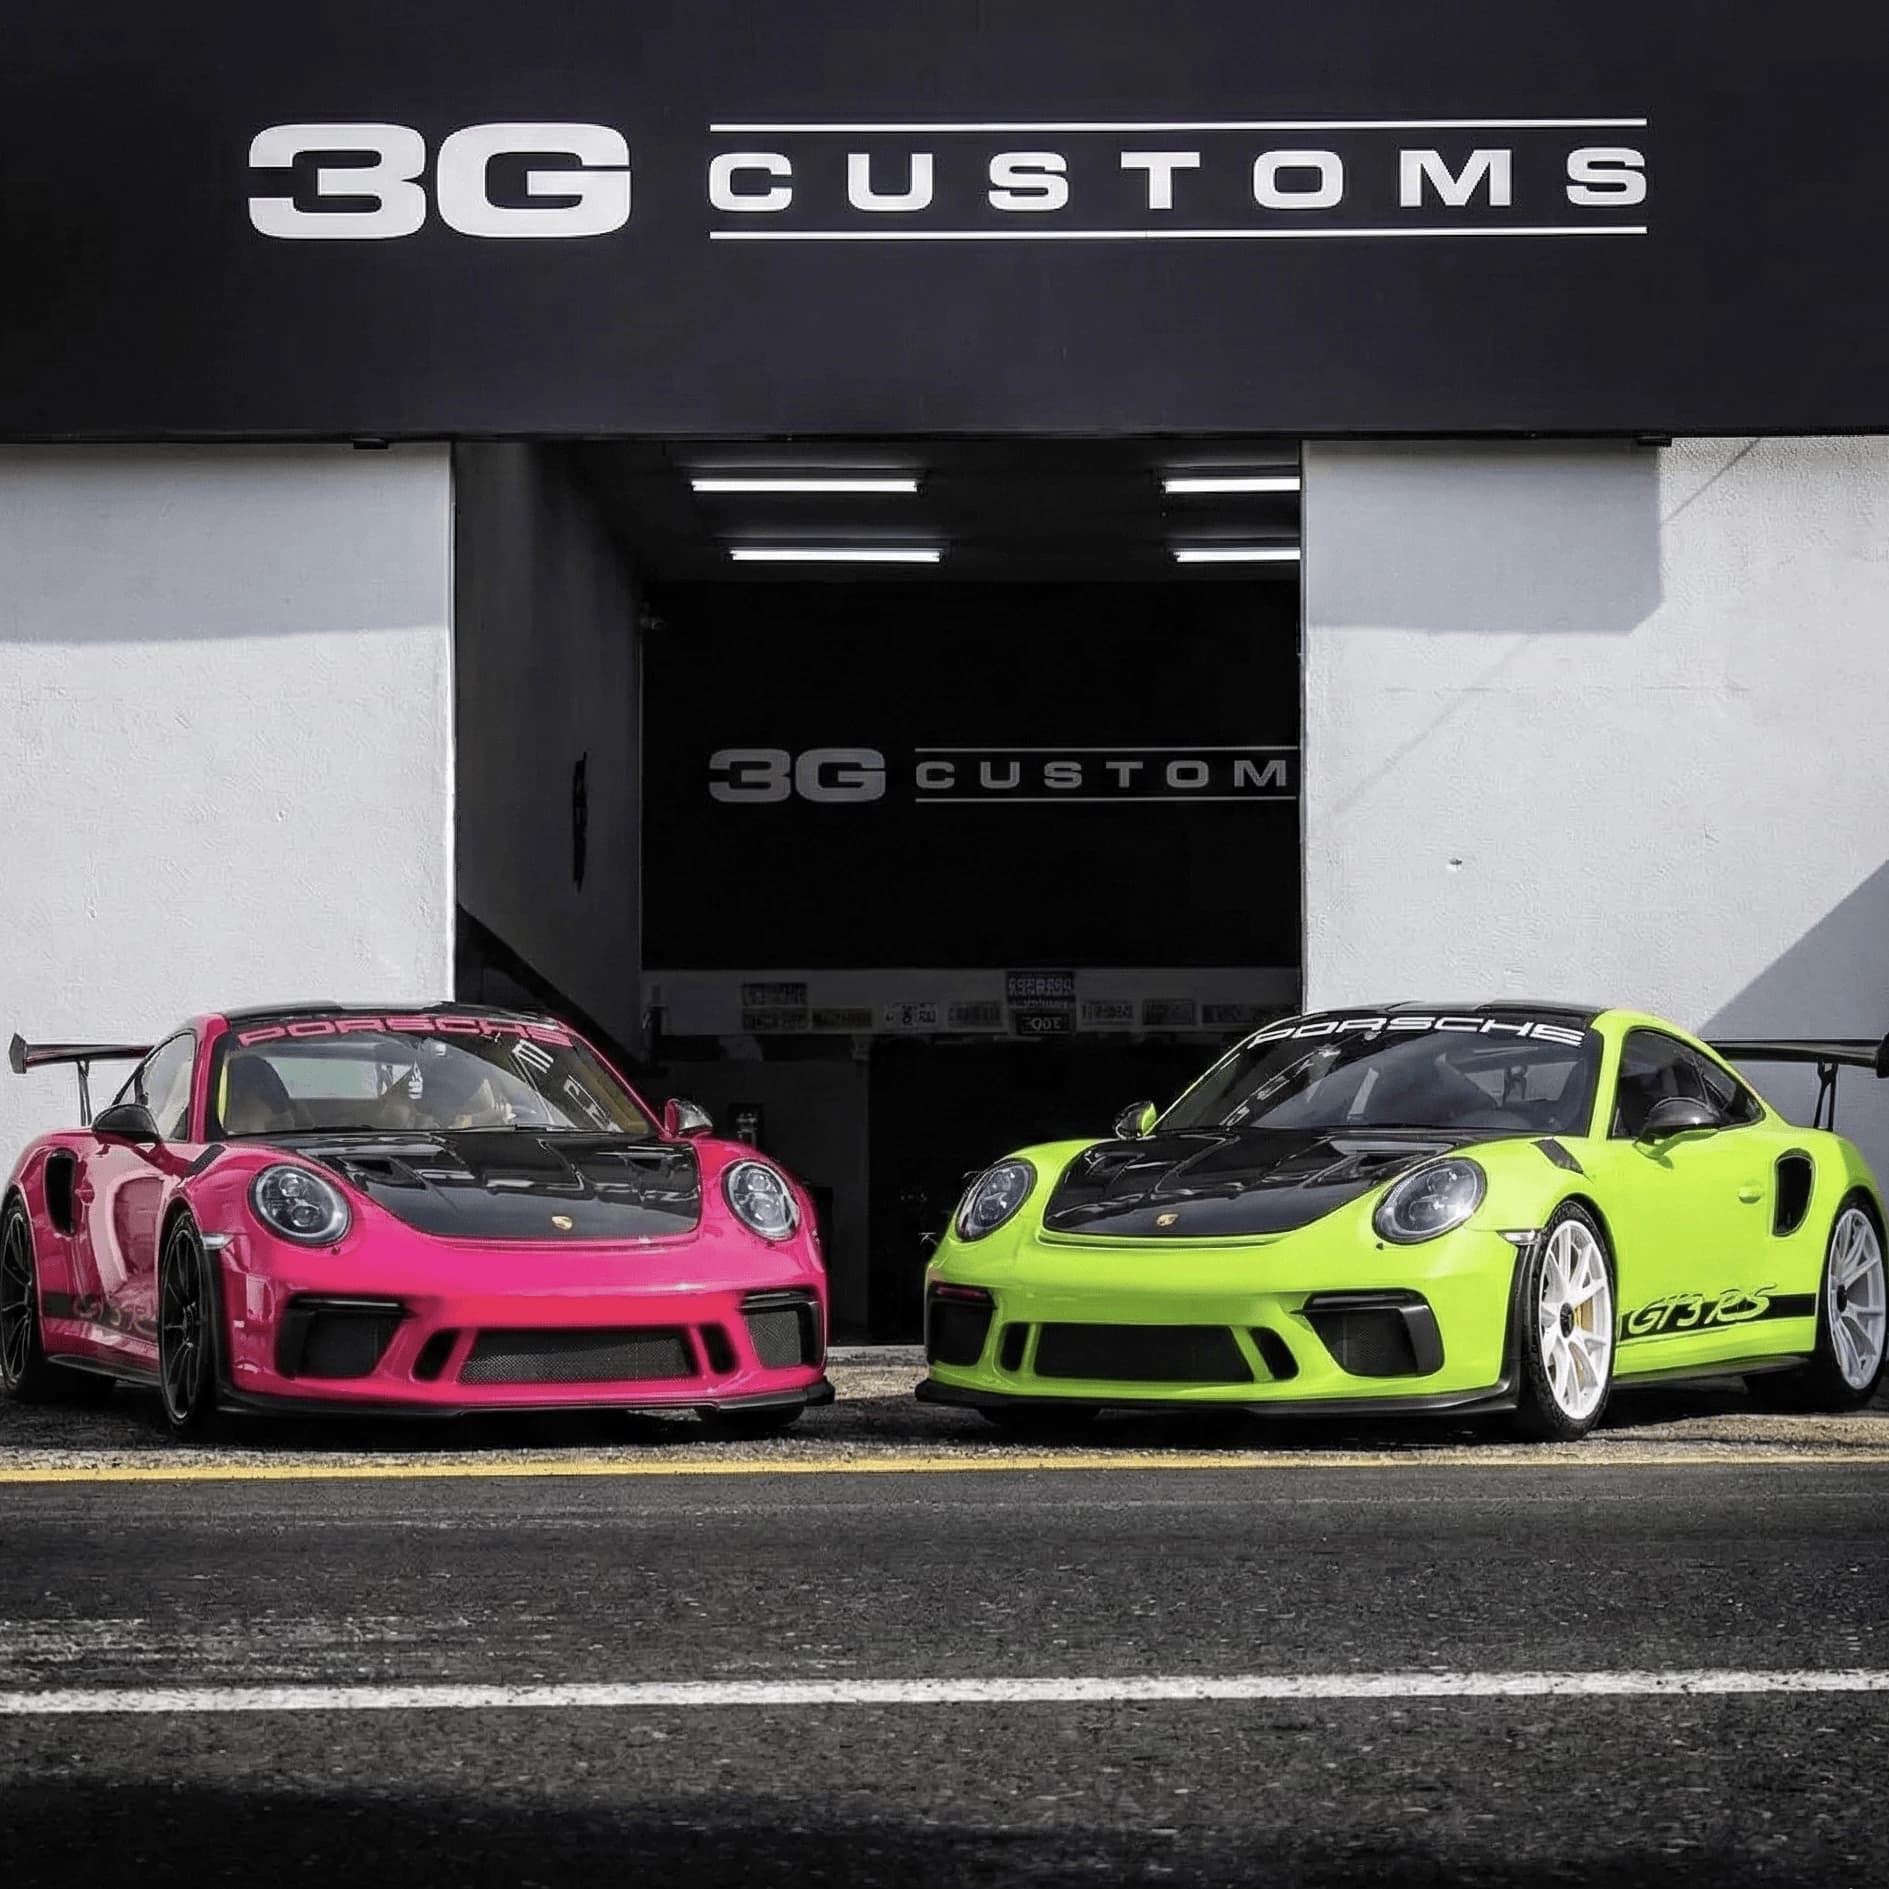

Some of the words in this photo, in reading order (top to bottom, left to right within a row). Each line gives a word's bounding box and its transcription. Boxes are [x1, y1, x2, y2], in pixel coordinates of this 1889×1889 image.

[248, 122, 631, 240] 3G
[707, 146, 1647, 211] CUSTOMS
[709, 747, 886, 803] 3G
[237, 1016, 574, 1048] PORSCHE
[1247, 1016, 1586, 1047] PORSCHE
[1627, 1292, 1704, 1335] GT3
[1704, 1282, 1777, 1323] RS
